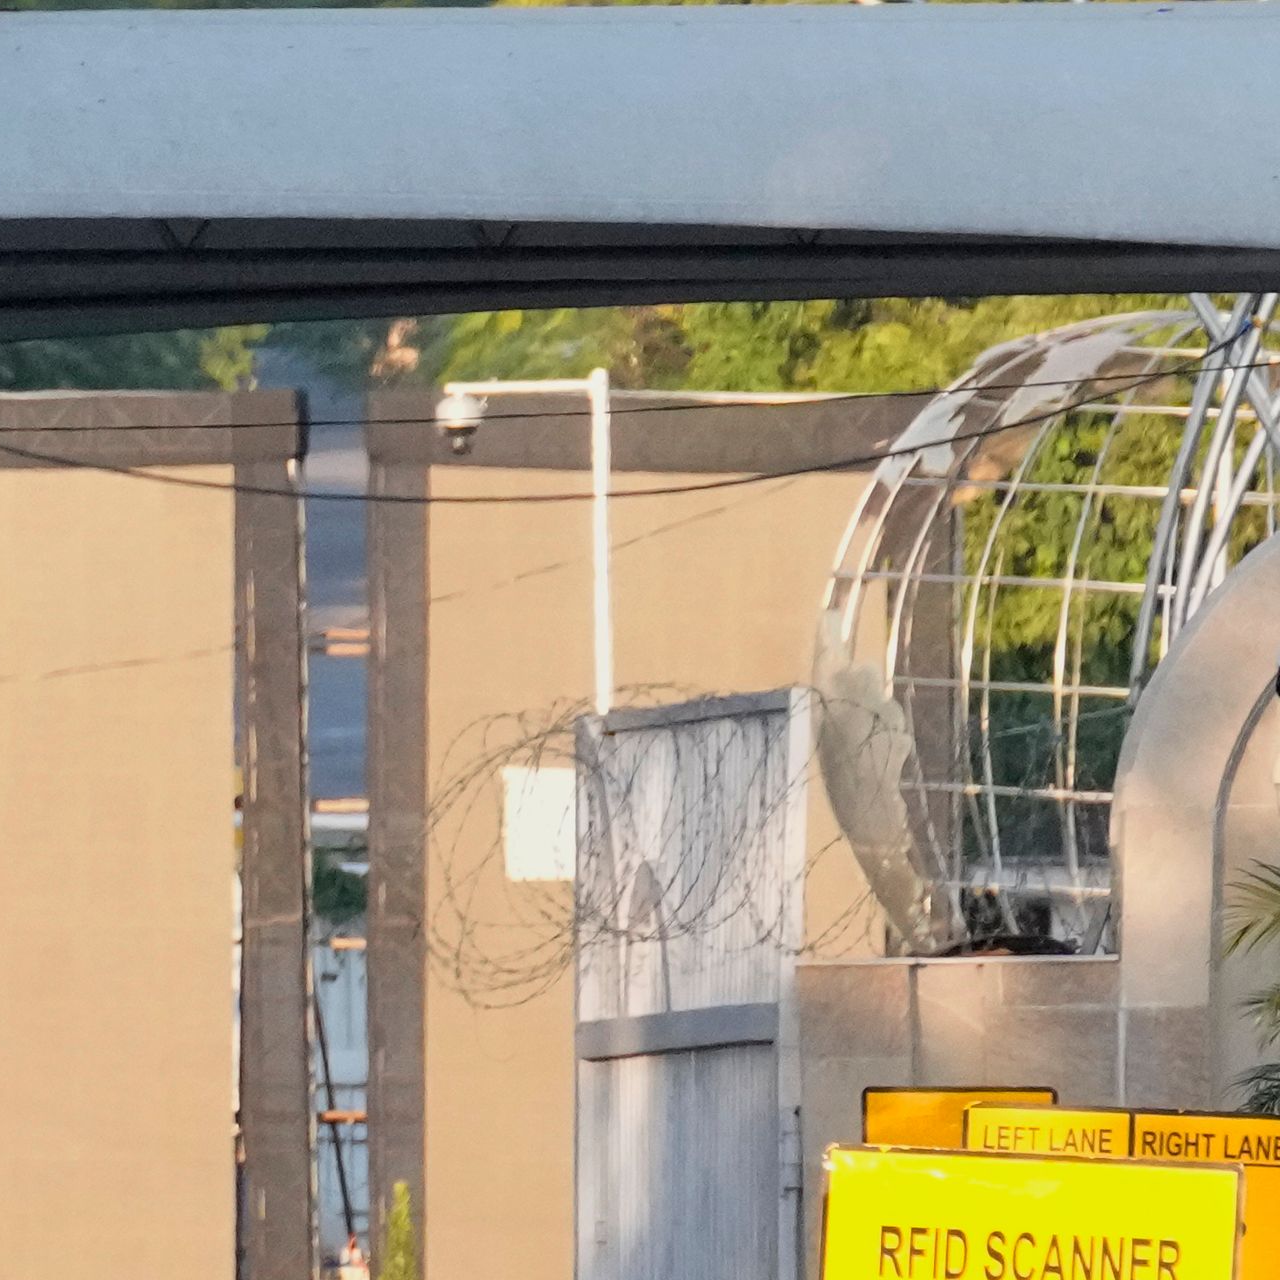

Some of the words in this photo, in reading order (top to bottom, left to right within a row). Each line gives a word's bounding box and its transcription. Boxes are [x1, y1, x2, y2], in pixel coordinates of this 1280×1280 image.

[983, 1124, 1040, 1150] LEFT
[1049, 1127, 1113, 1154] LANE
[1142, 1130, 1216, 1158] RIGHT
